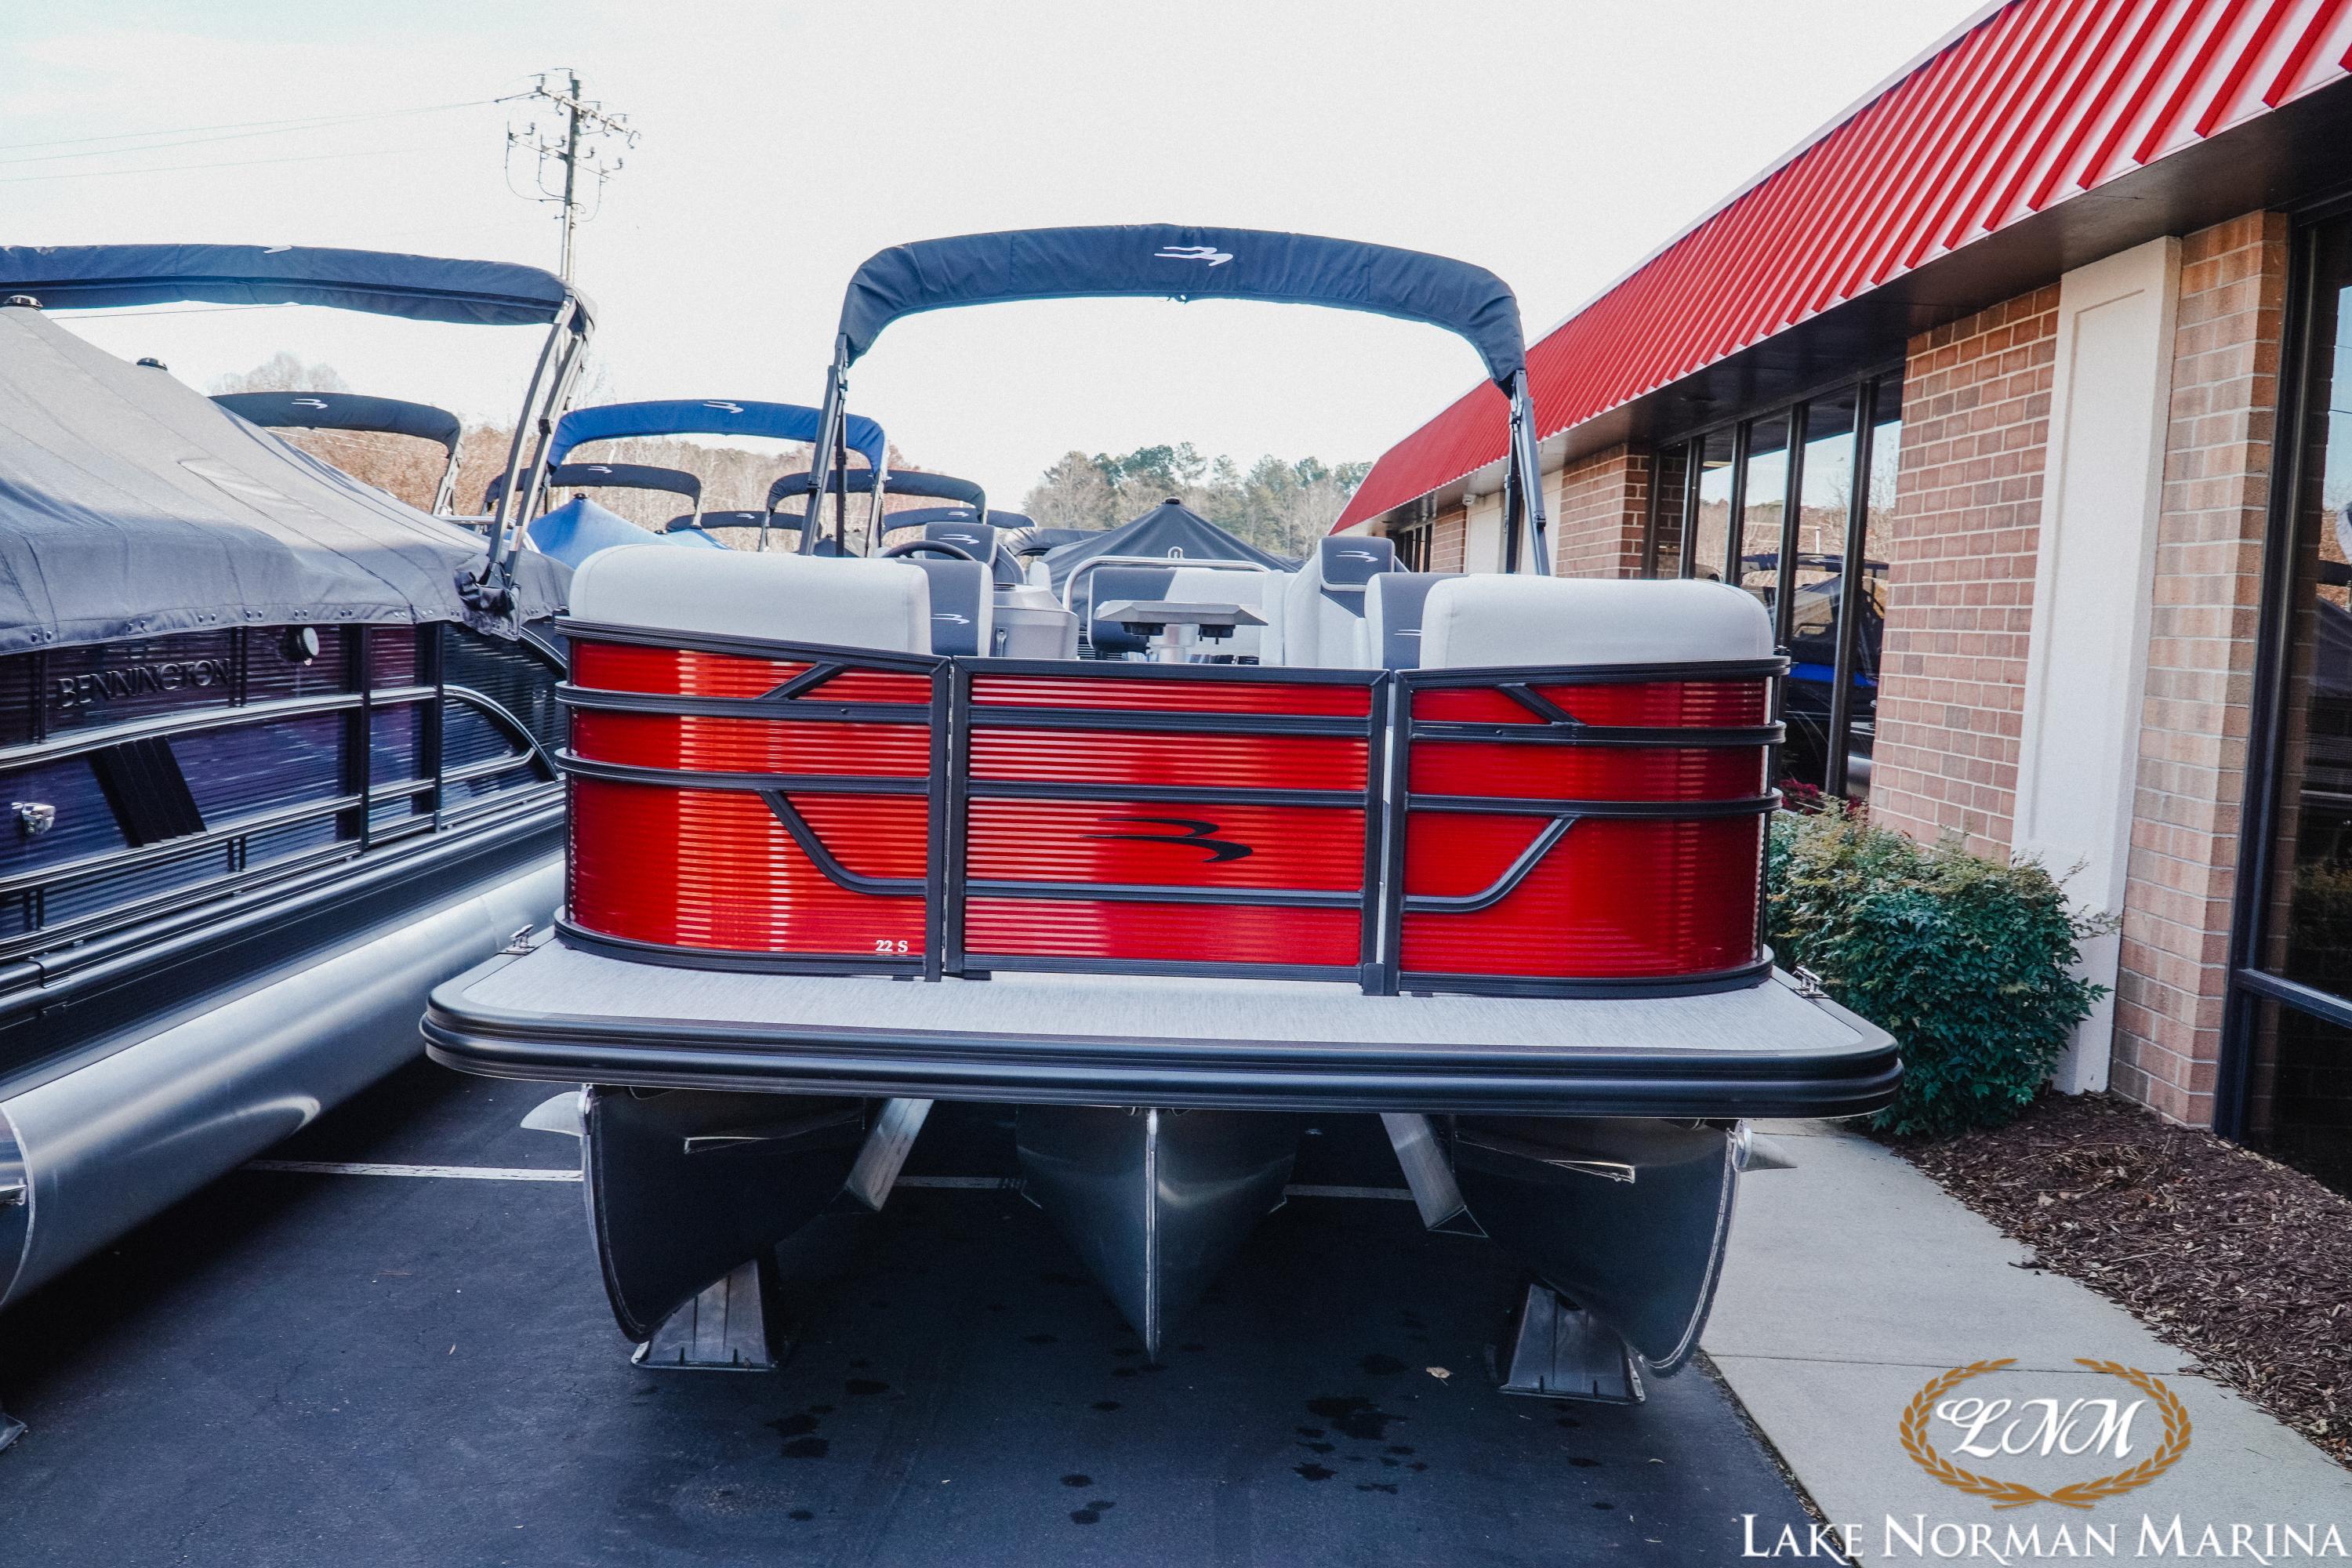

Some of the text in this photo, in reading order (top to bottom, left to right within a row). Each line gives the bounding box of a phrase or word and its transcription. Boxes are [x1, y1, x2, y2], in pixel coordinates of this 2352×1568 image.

[56, 658, 230, 710] BENNINGTON
[875, 939, 909, 953] 22 S
